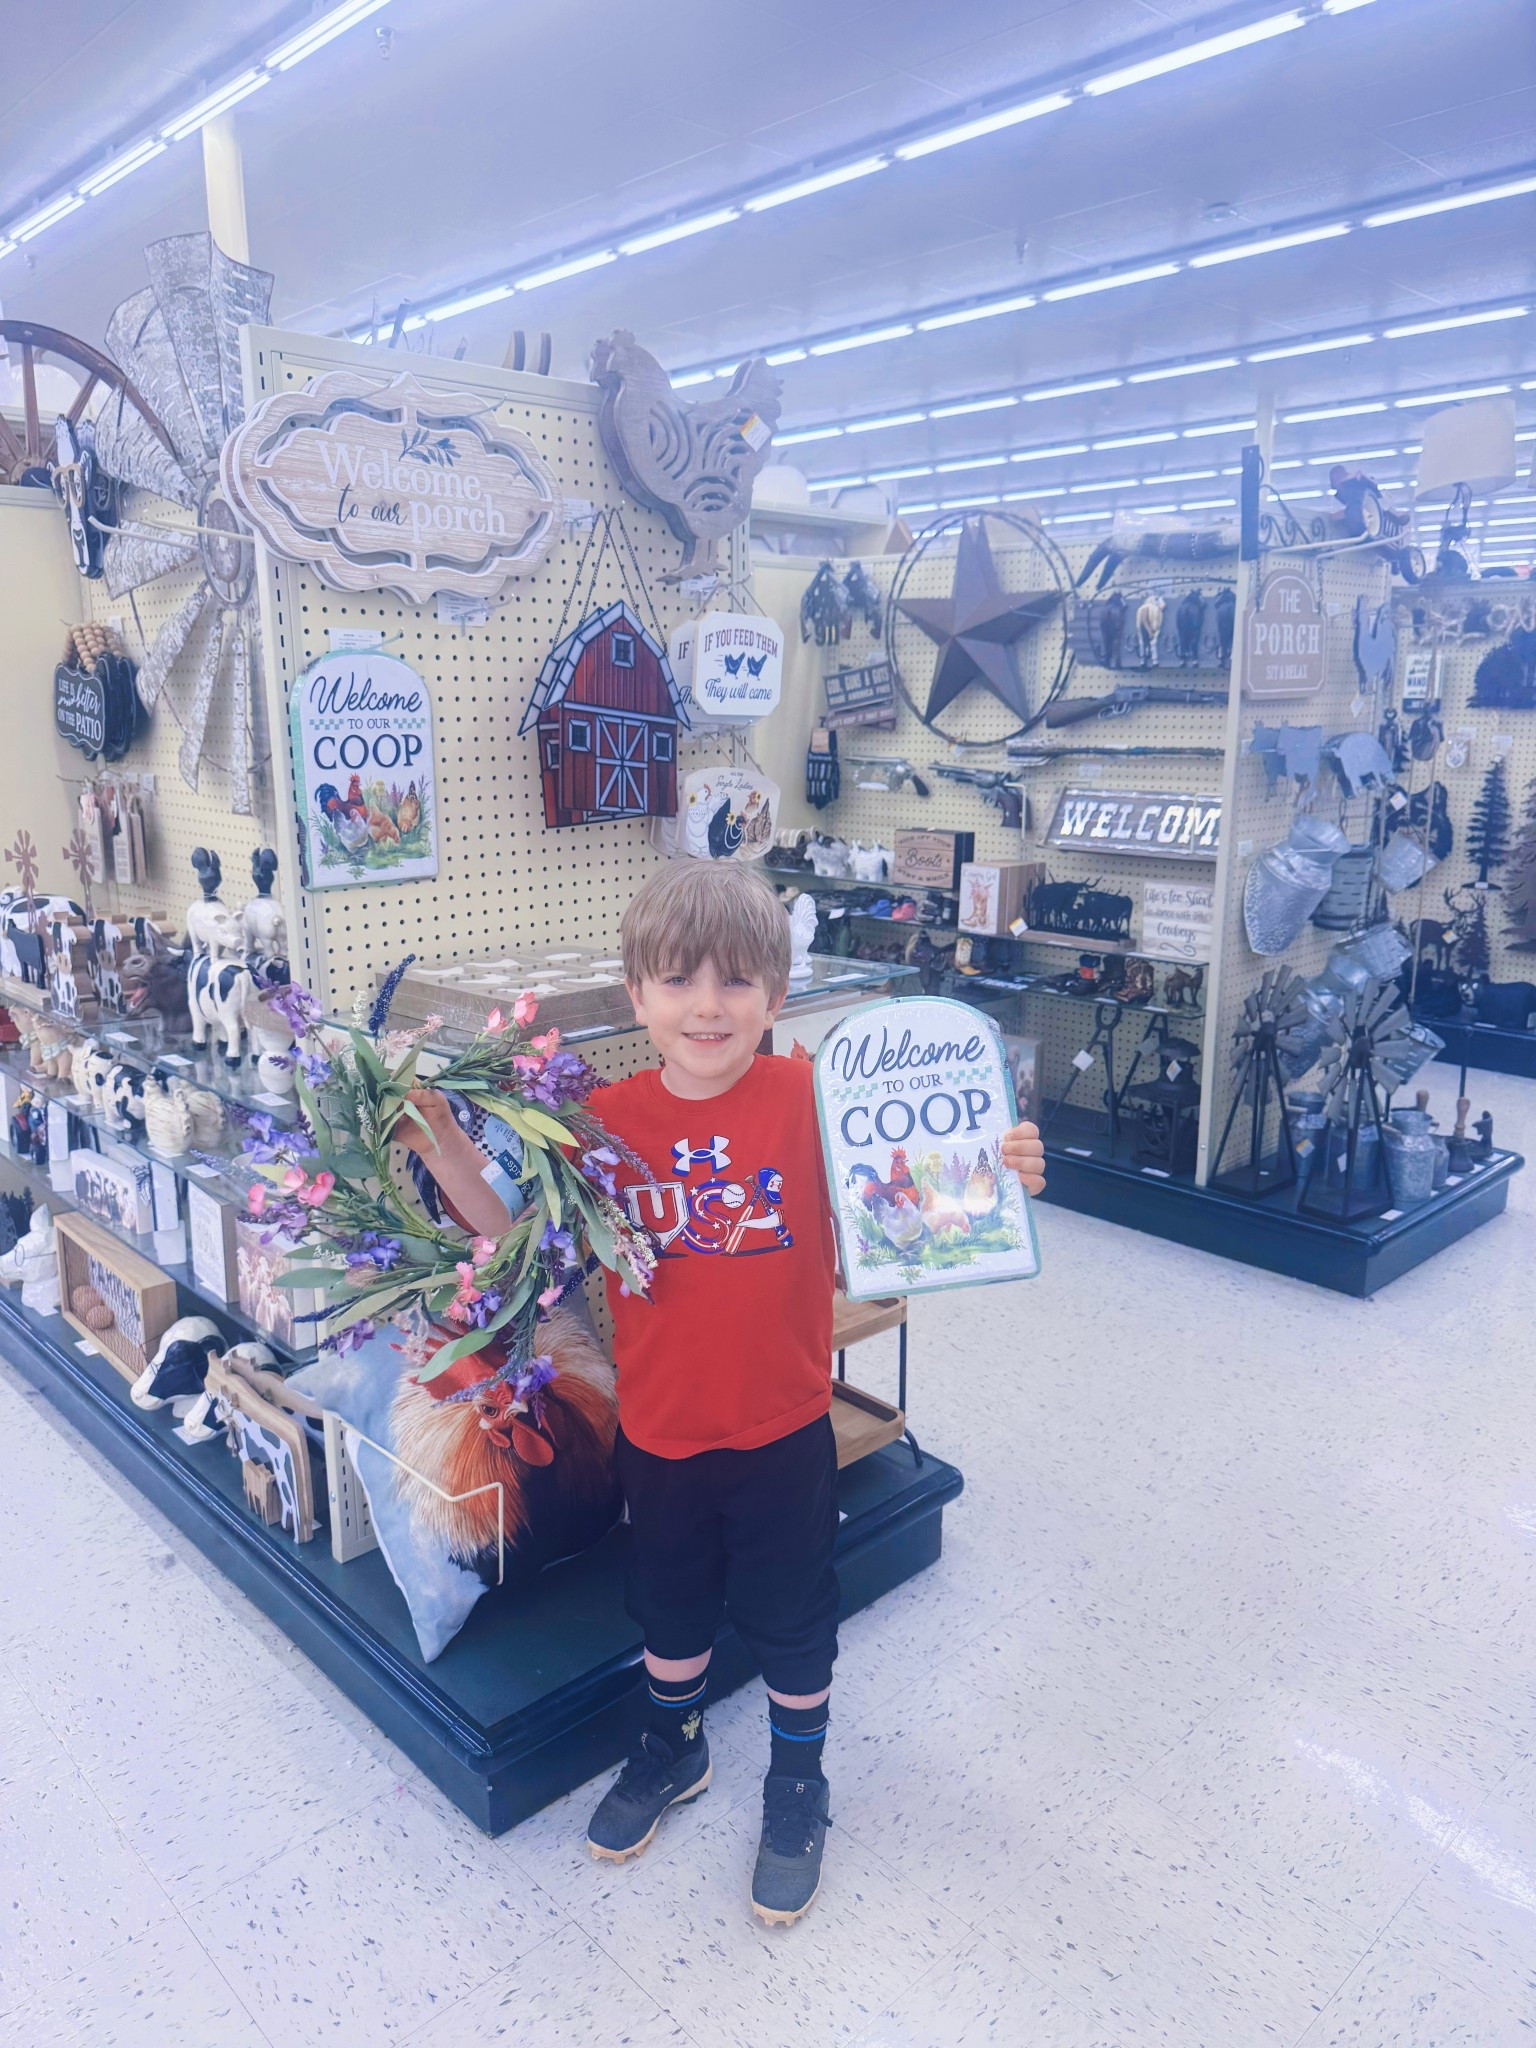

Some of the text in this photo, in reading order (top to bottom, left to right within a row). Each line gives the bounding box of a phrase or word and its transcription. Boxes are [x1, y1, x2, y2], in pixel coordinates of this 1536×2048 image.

[315, 440, 482, 501] Welcome
[337, 483, 508, 544] to our porch
[1278, 589, 1301, 613] THE
[678, 640, 690, 660] IF
[704, 628, 778, 658] IF YOU FEED THEM
[1254, 622, 1321, 655] PORCH
[1266, 664, 1278, 680] SIT
[1285, 664, 1308, 680] RELAX
[309, 671, 423, 714] Welcome
[705, 678, 773, 703] They will come
[75, 712, 102, 741] PATIO
[347, 718, 391, 729] TO OUR
[313, 733, 423, 770] COOP
[733, 778, 754, 790] Ladies
[1060, 800, 1221, 846] WELCOM
[904, 847, 943, 868] Boots
[831, 1026, 986, 1082] Welcome
[882, 1073, 943, 1093] TO OUR
[840, 1088, 992, 1147] COOP
[623, 1176, 794, 1255] USA
